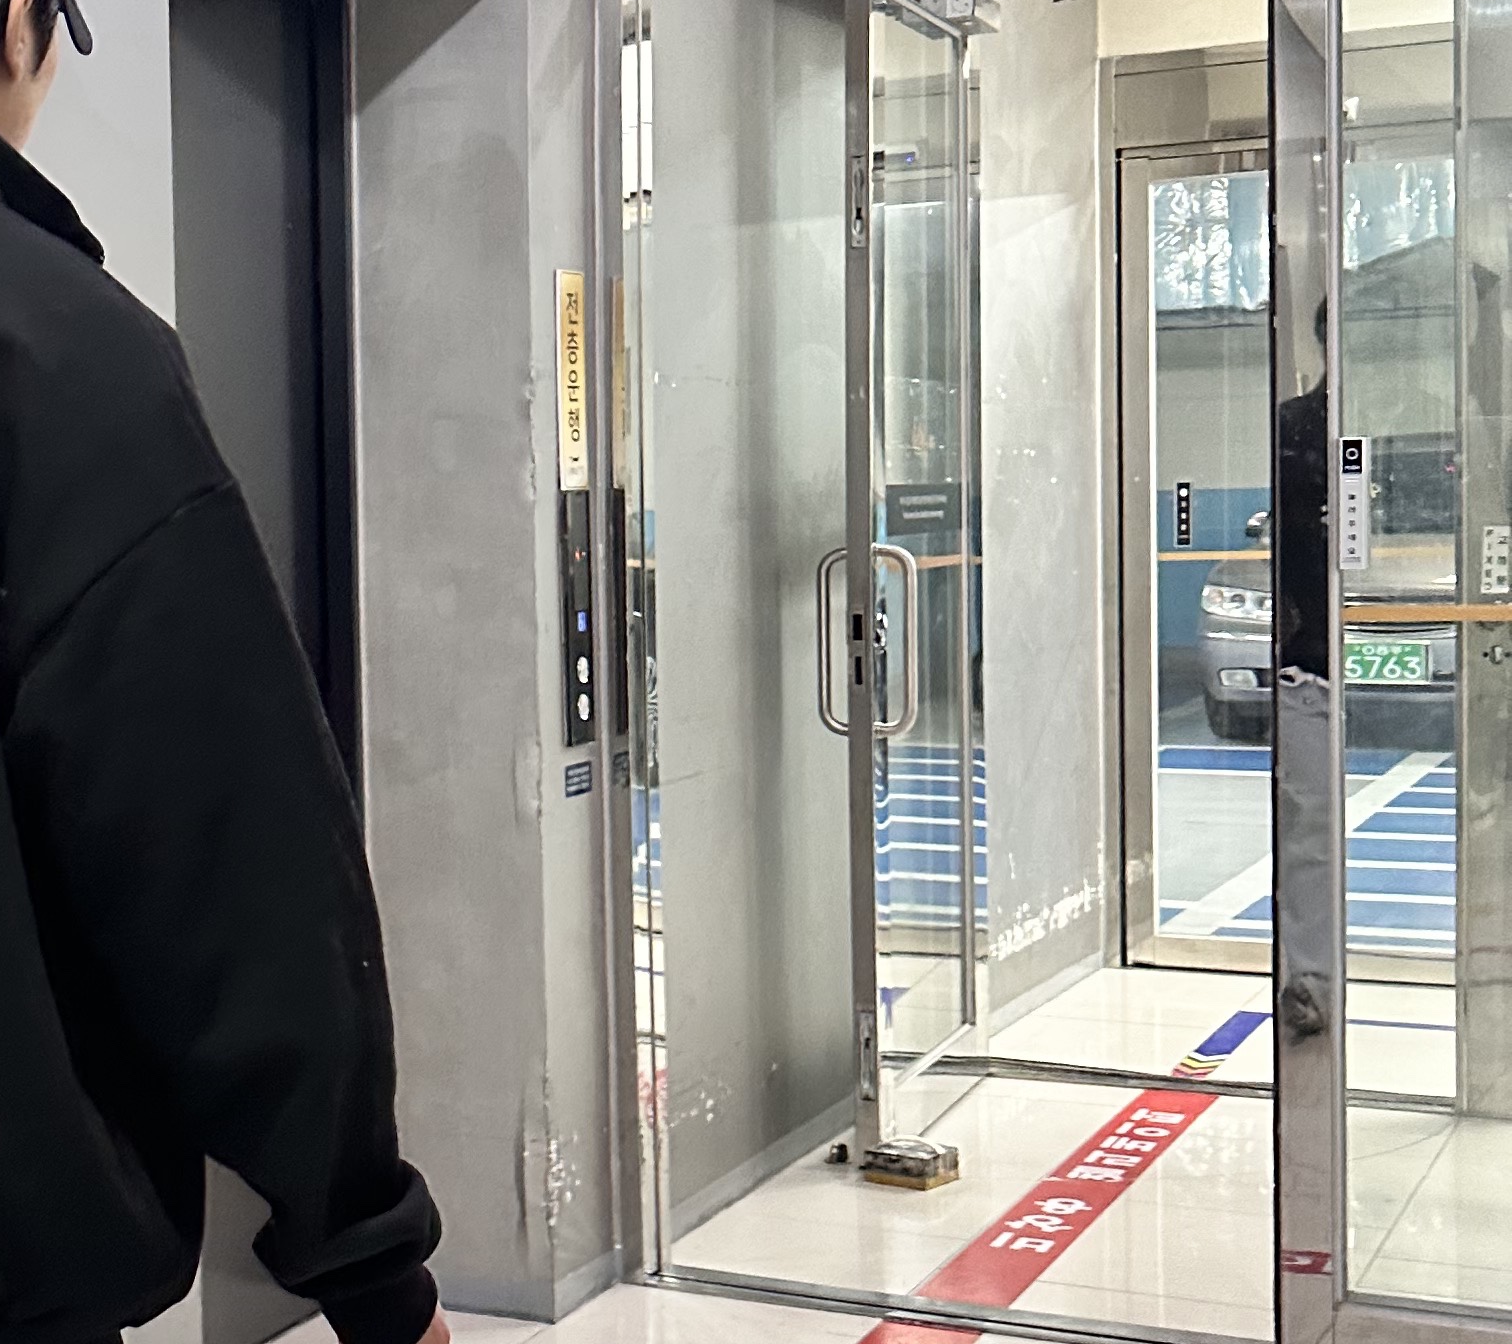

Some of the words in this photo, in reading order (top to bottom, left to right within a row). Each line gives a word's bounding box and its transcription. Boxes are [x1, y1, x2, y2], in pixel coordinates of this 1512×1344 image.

[1344, 656, 1421, 679] 5763
[990, 1196, 1093, 1254] 비상용
[1067, 1107, 1187, 1184] 엘리베이터
